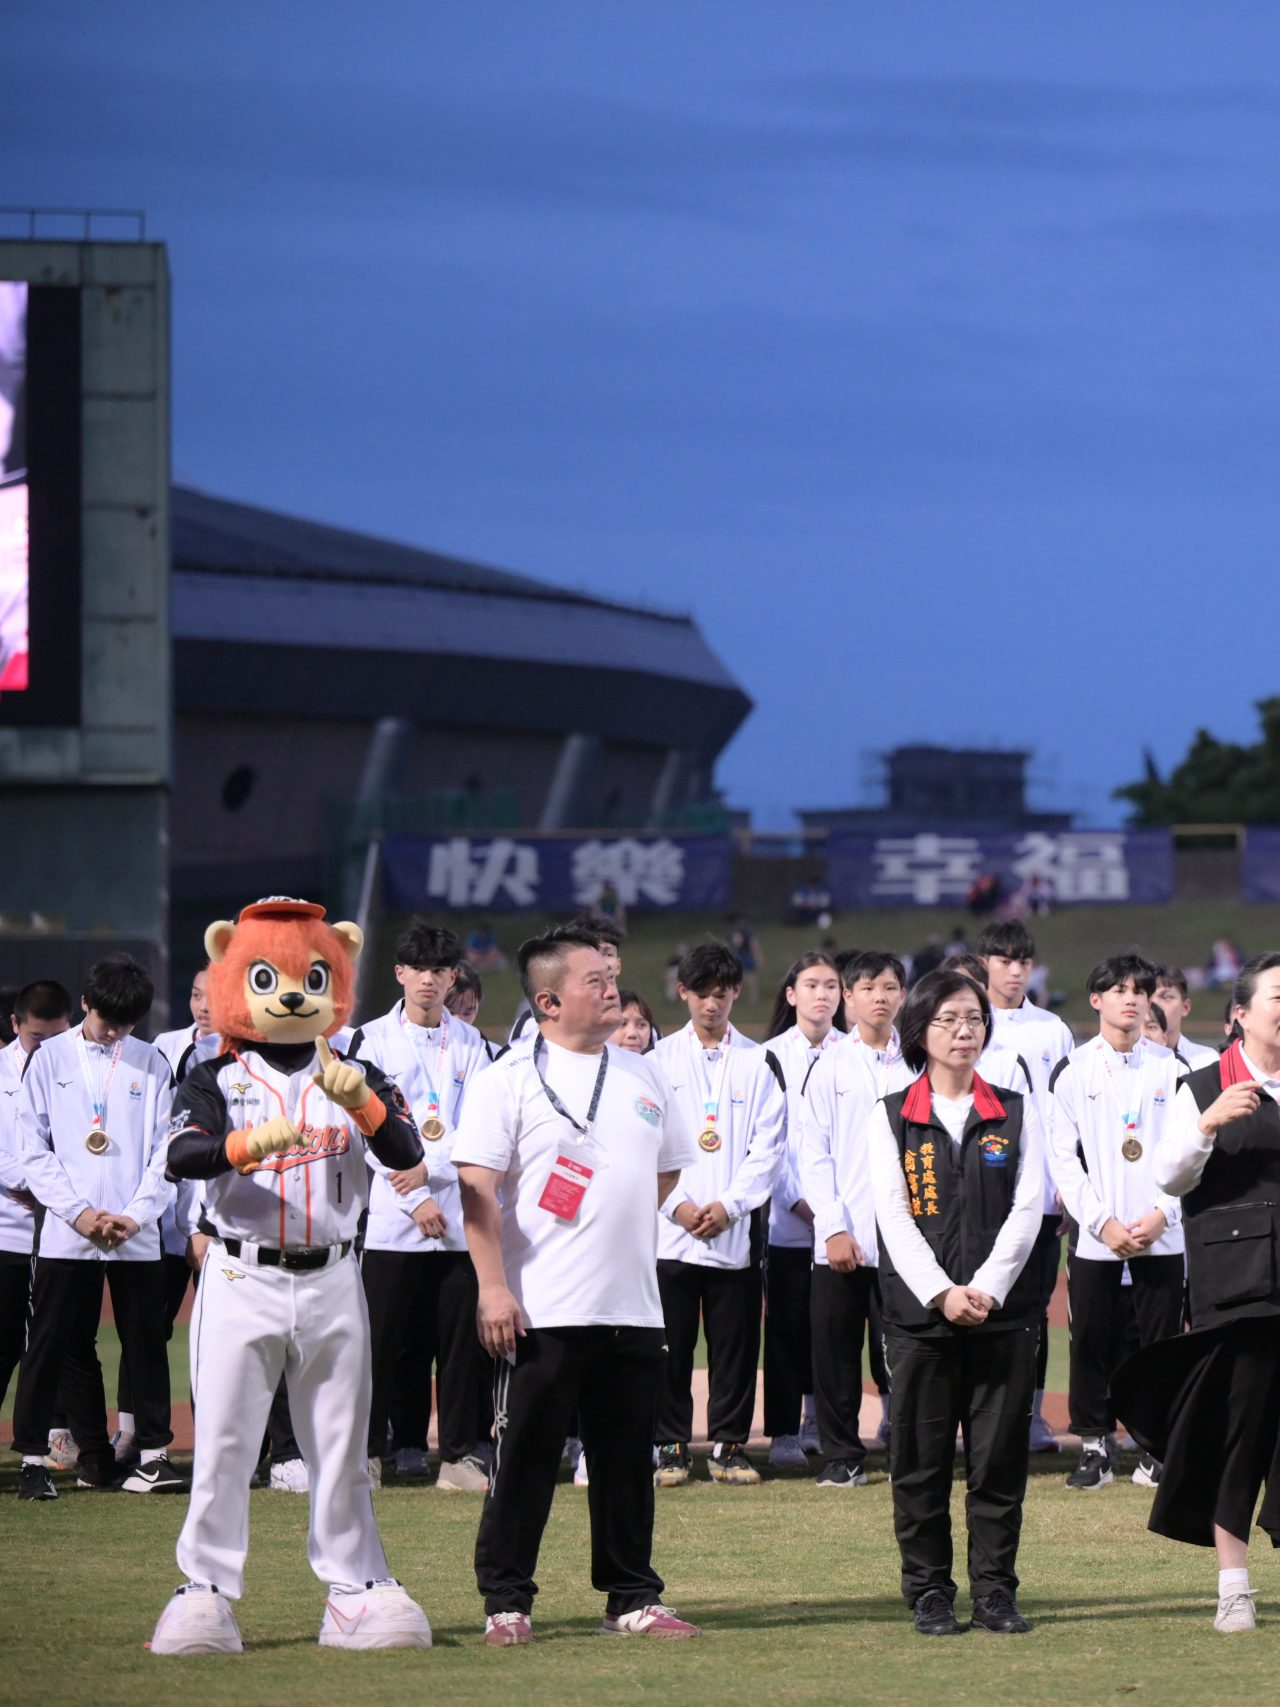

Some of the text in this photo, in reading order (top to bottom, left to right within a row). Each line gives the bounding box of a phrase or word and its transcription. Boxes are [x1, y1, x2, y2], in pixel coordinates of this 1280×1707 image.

[427, 836, 686, 906] 快樂
[871, 831, 1128, 904] 幸福
[335, 1171, 342, 1204] 1
